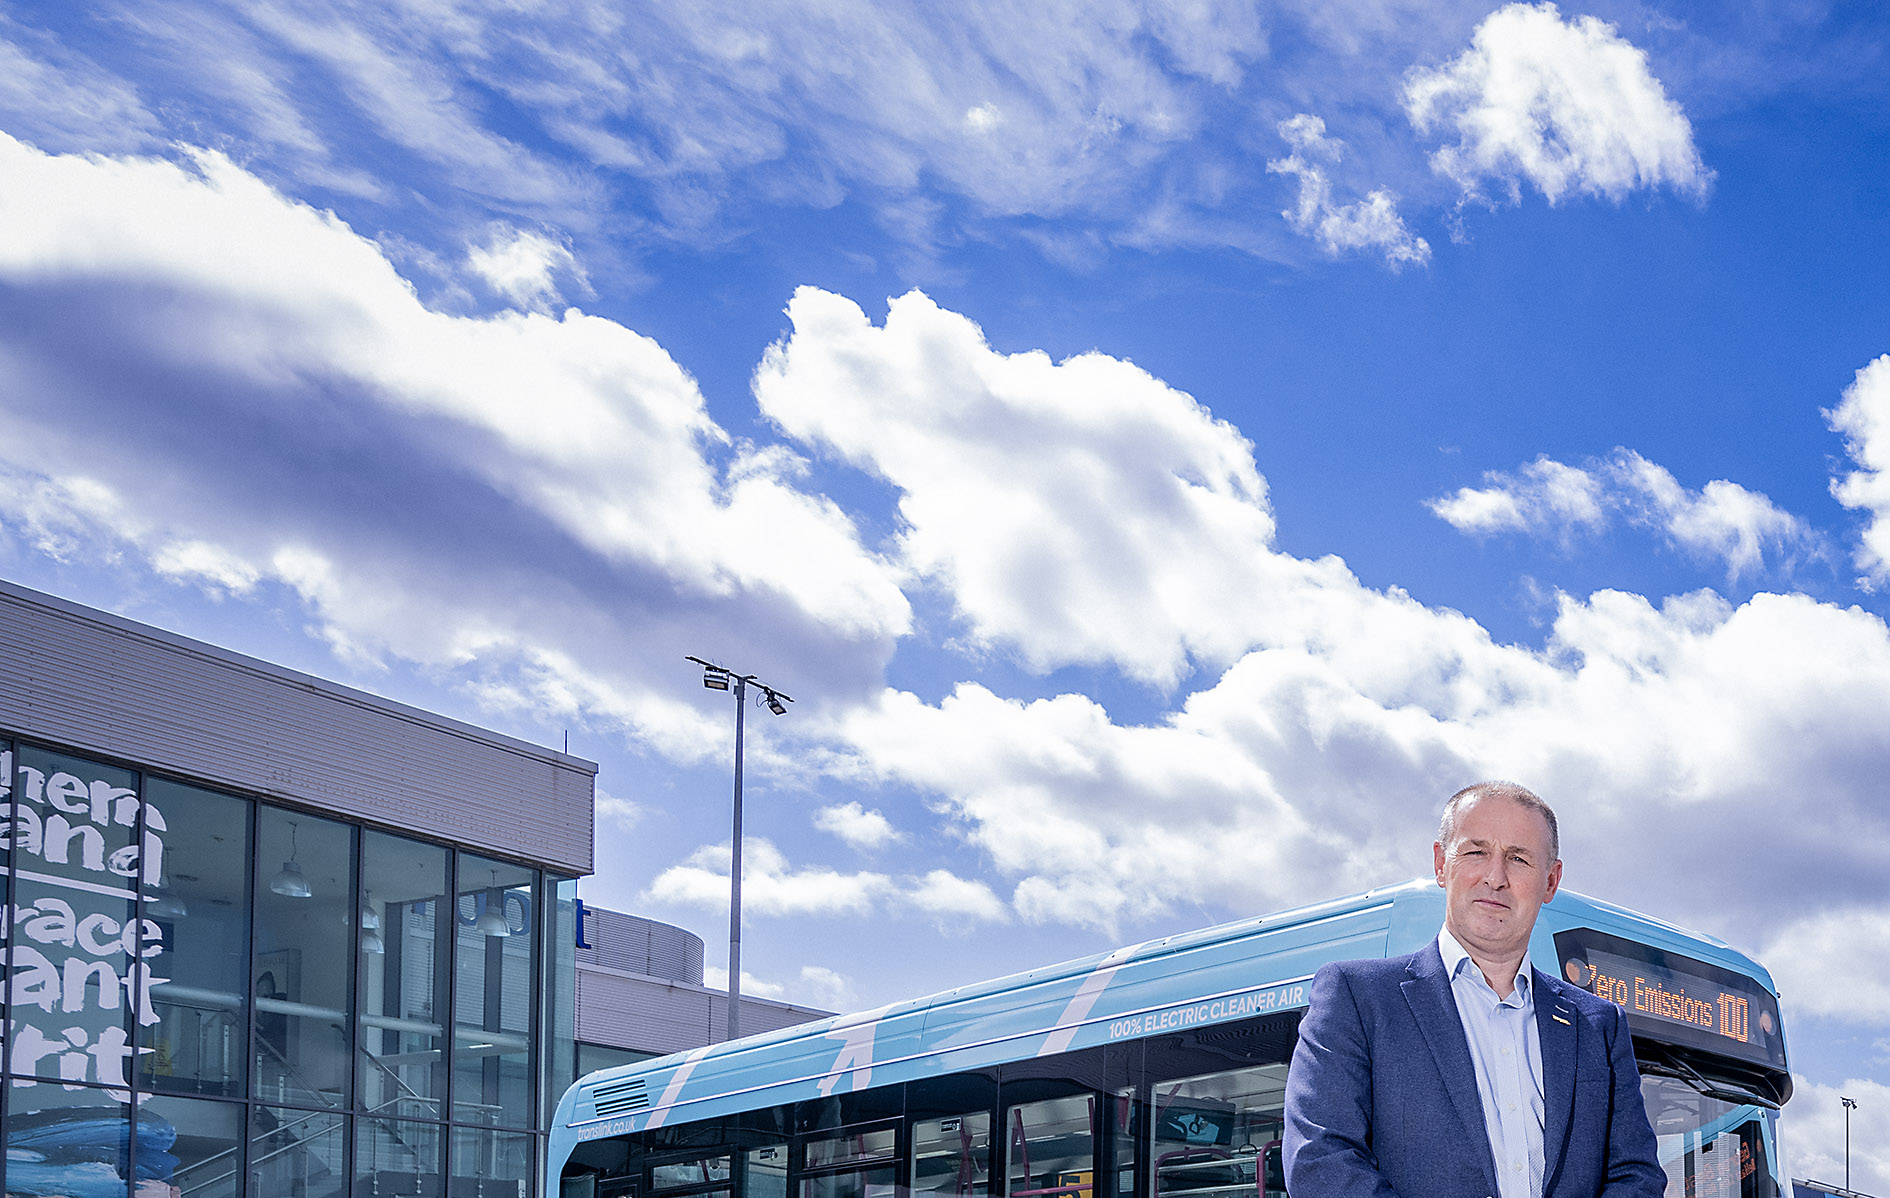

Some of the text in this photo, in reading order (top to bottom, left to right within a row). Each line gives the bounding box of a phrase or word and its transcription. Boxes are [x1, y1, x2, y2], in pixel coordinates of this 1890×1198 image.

[1109, 986, 1304, 1039] 100% ELECTRIC CLEANER AIR
[1584, 964, 1749, 1043] Zero Emissions 100
[0, 1020, 158, 1105] rit
[577, 1115, 636, 1141] translink.co.uk
